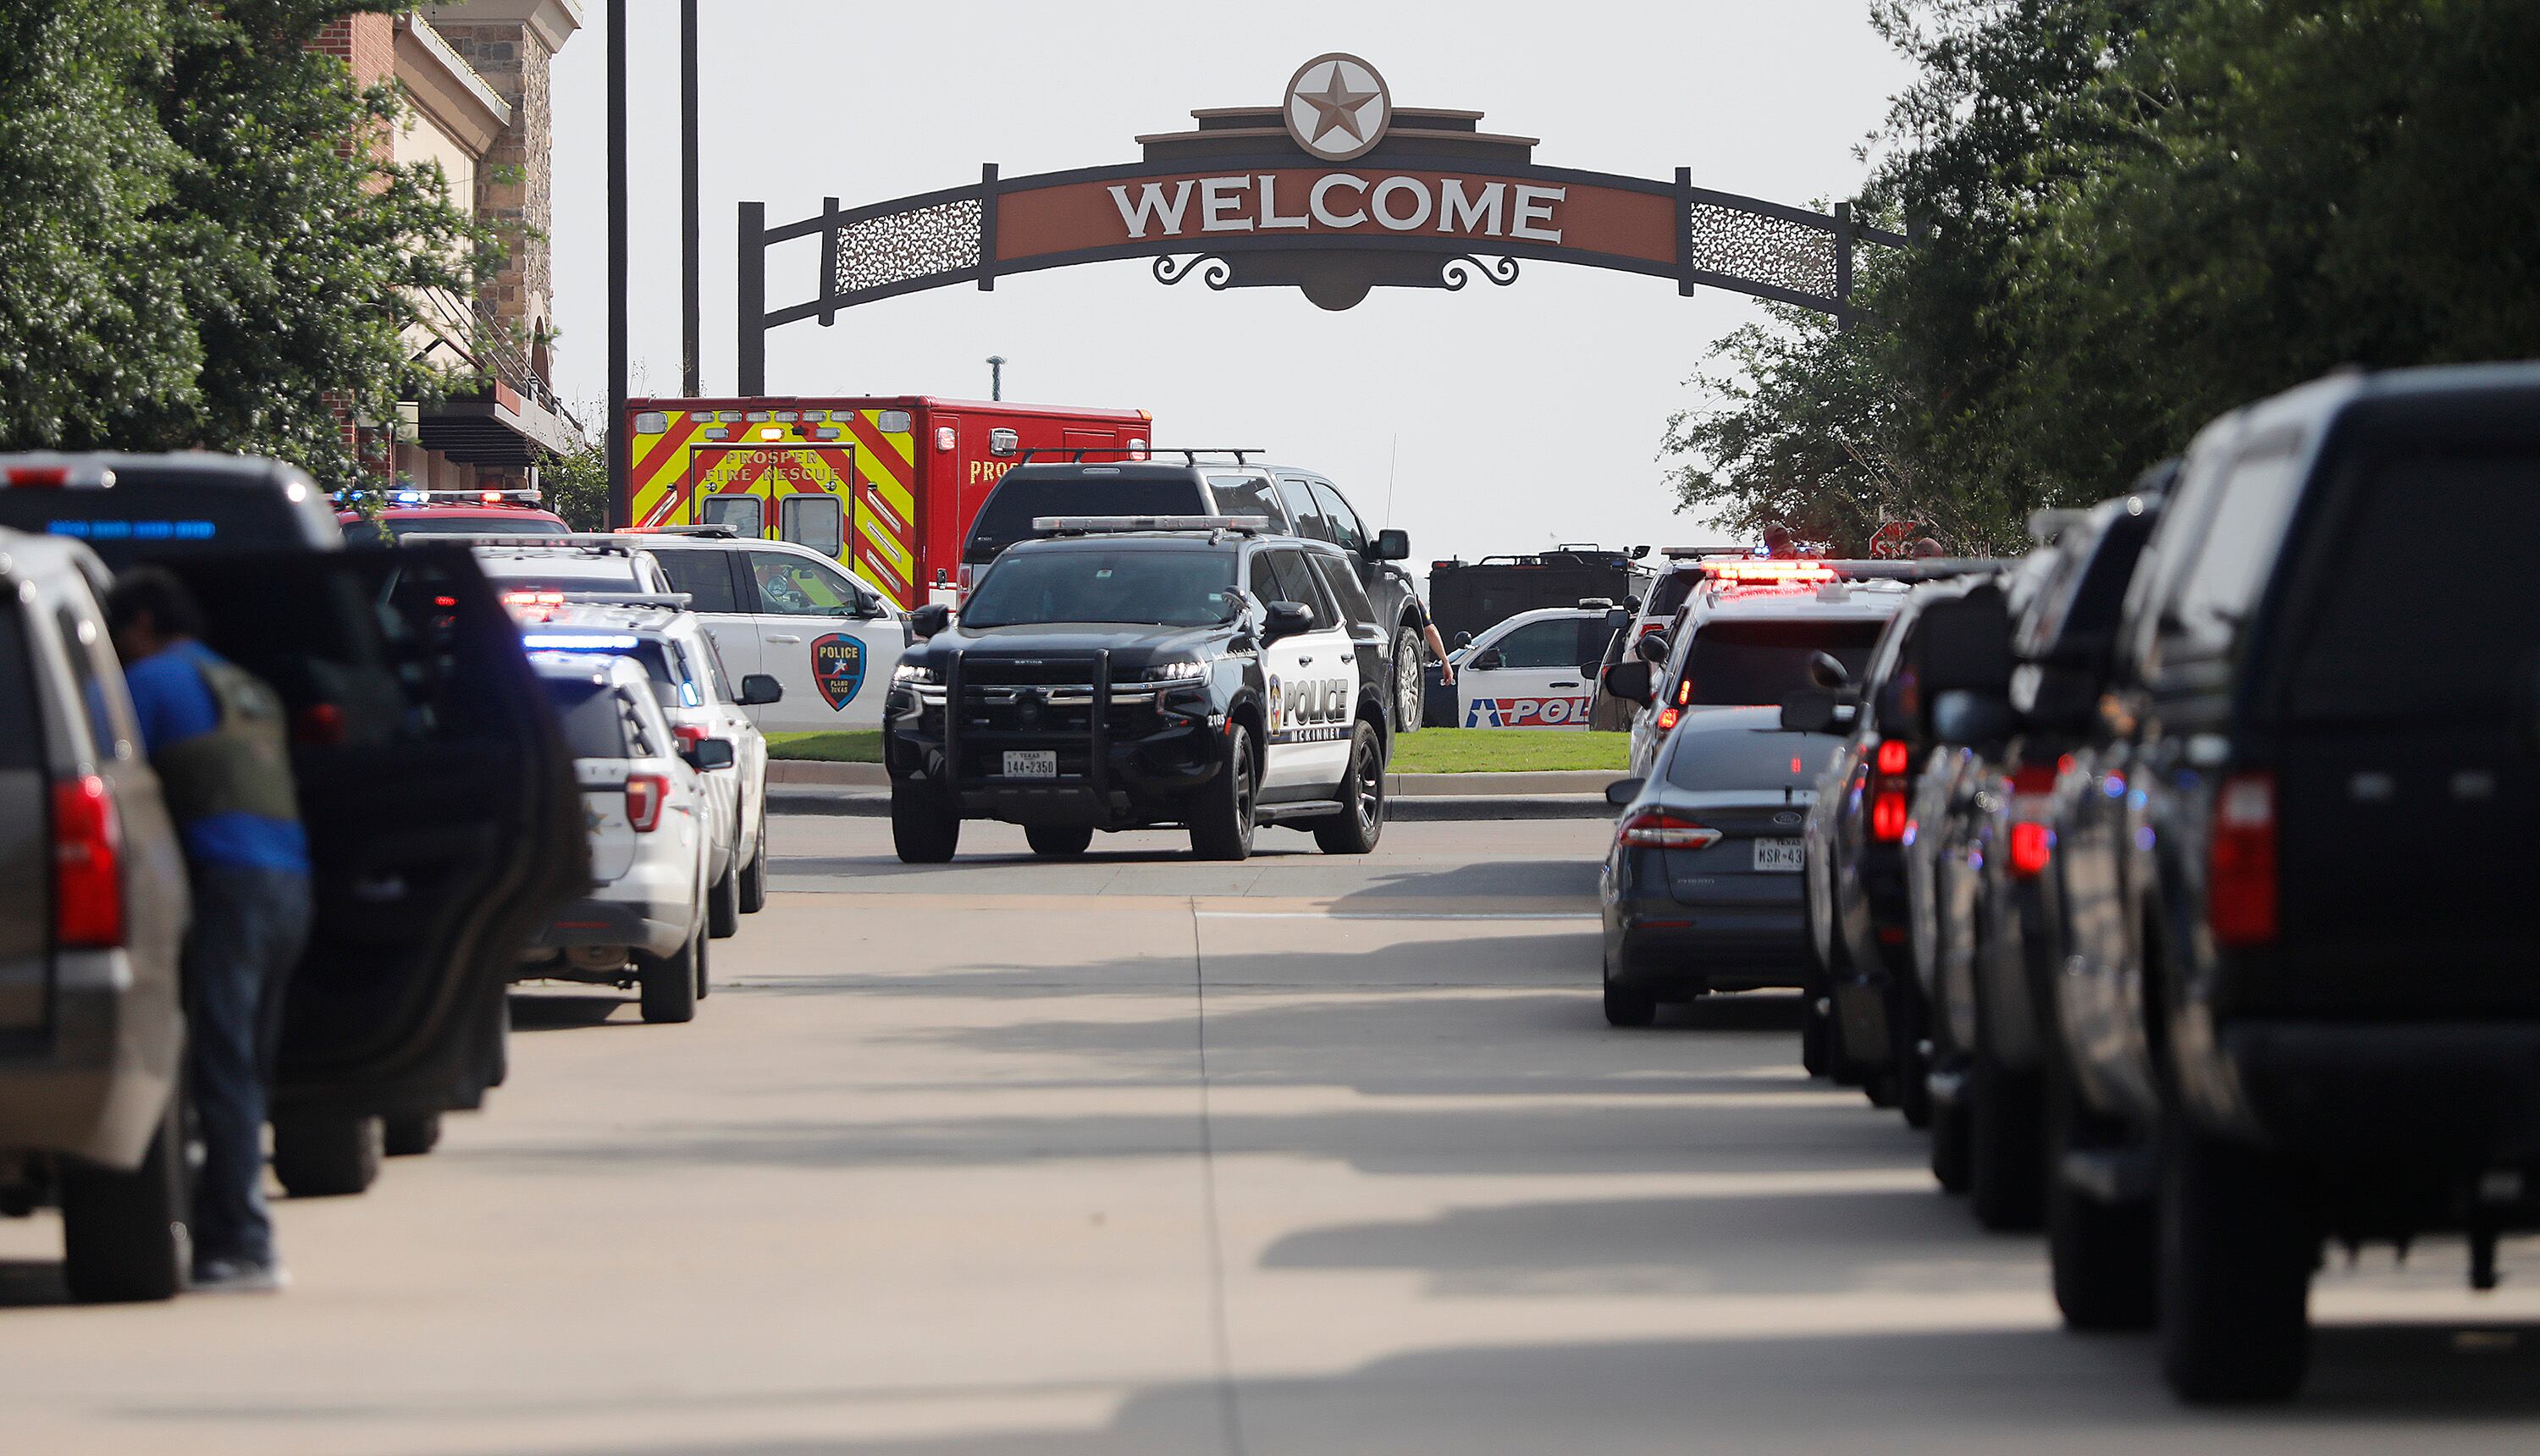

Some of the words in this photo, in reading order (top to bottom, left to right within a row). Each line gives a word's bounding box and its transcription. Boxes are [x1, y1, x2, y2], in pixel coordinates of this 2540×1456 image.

[1107, 173, 1566, 244] WELCOME
[726, 451, 818, 465] PROSPER
[705, 468, 752, 481] FIRE
[764, 468, 840, 481] RESCUE
[820, 647, 858, 658] POLICE
[1284, 679, 1349, 726] POLICE
[1292, 728, 1340, 742] MCKINNEY
